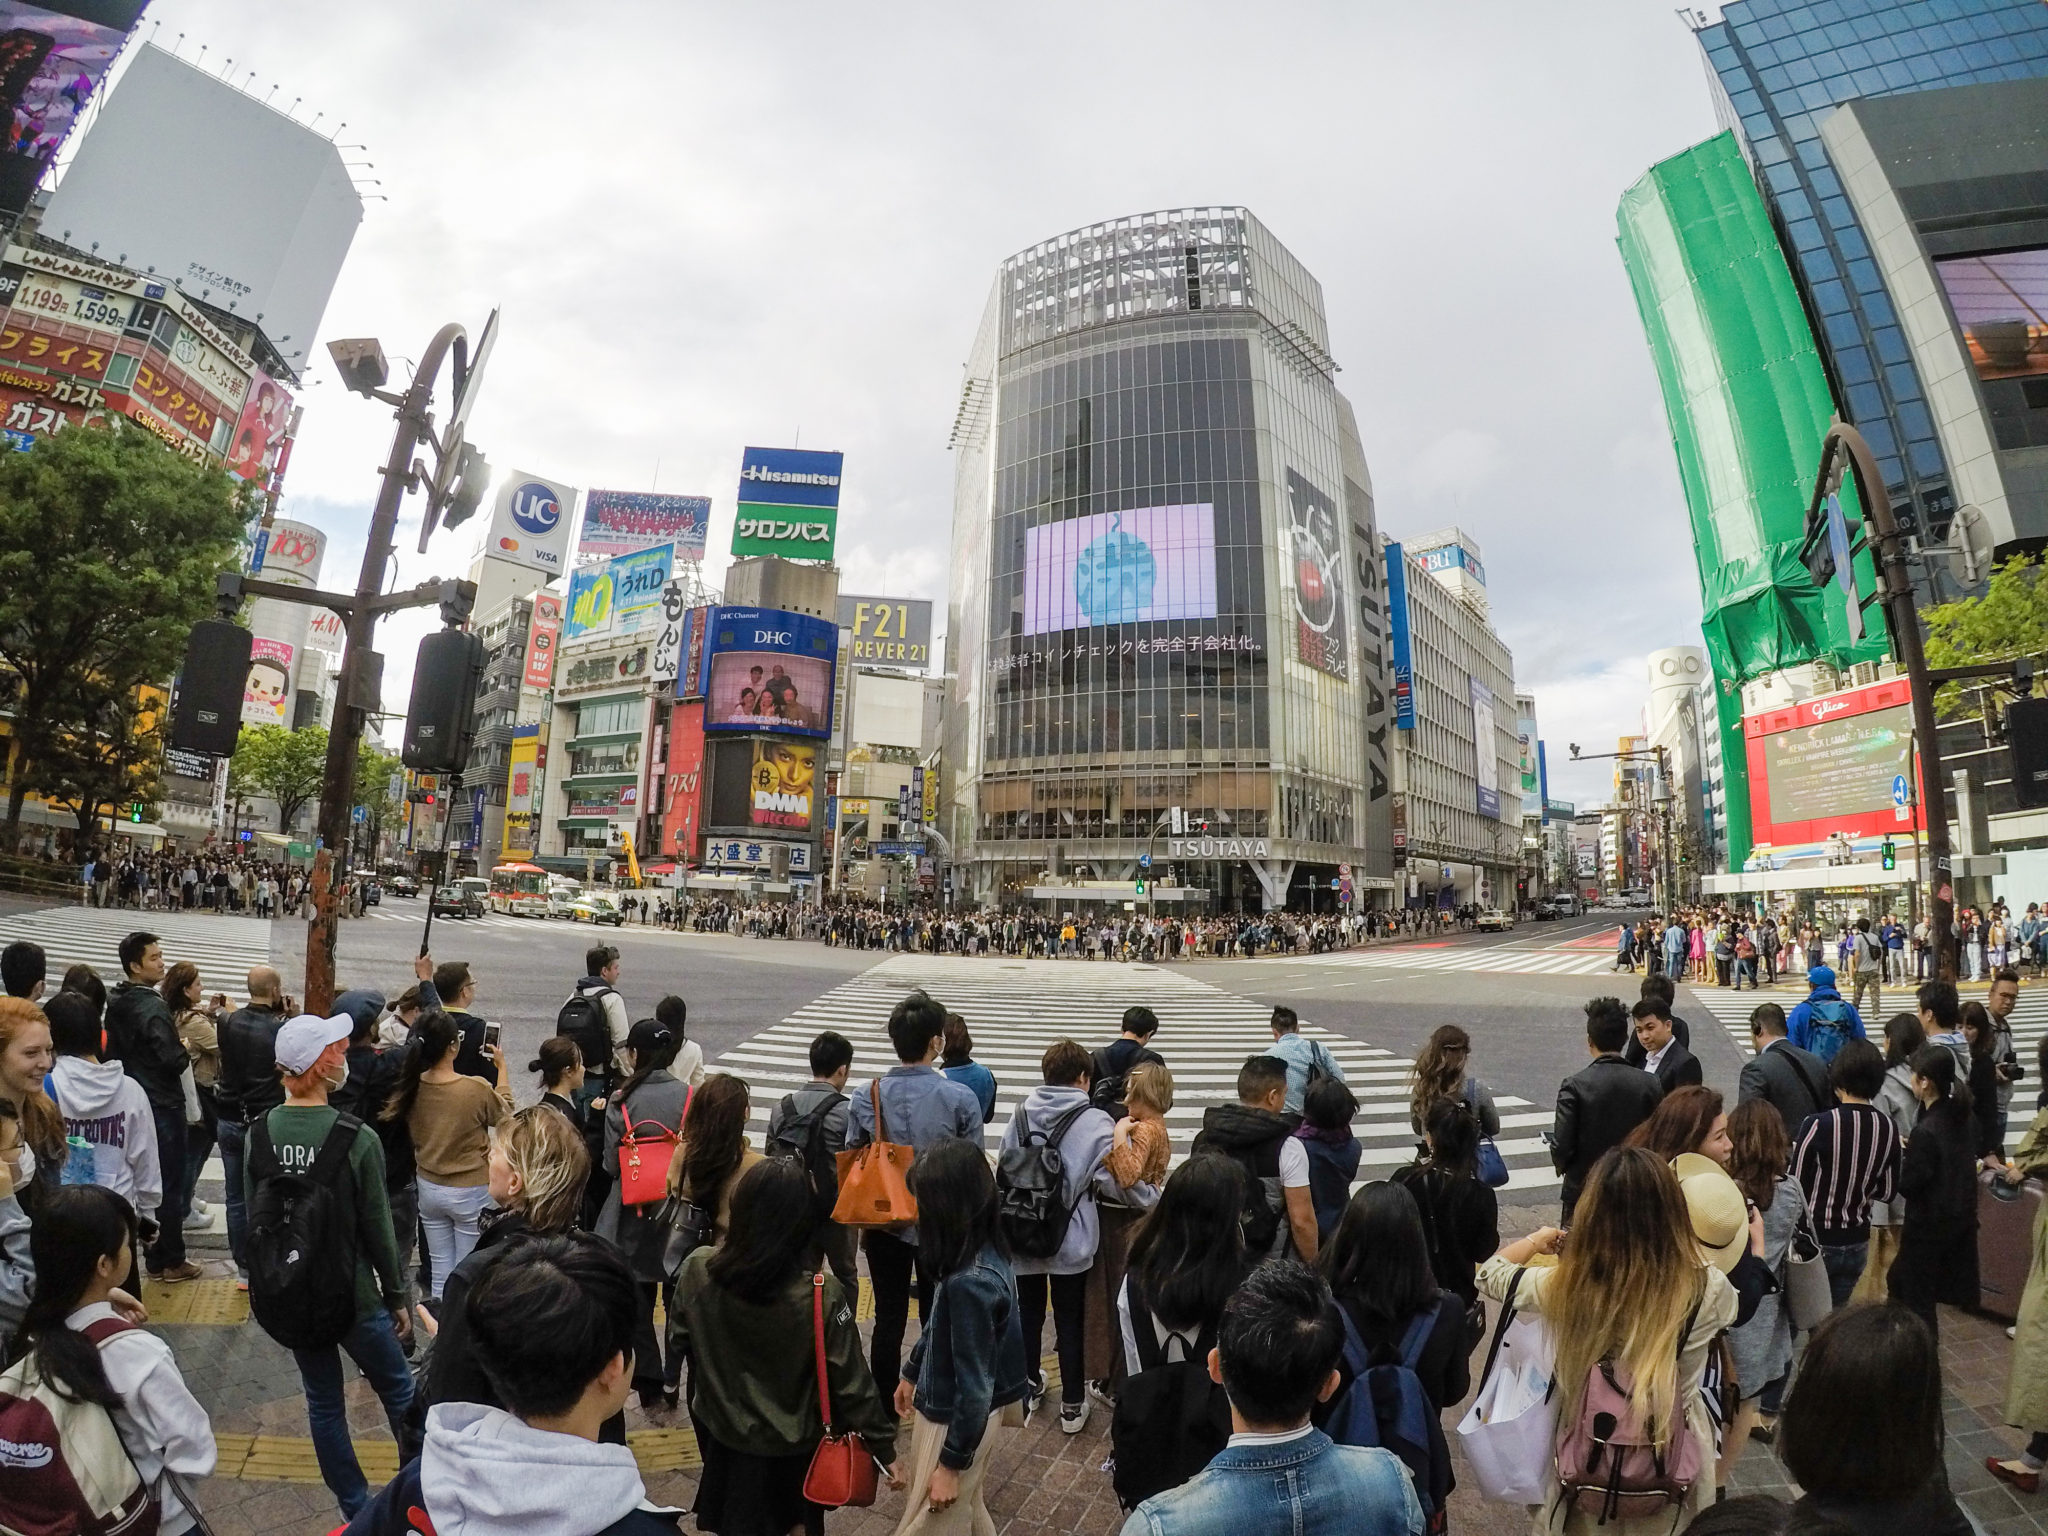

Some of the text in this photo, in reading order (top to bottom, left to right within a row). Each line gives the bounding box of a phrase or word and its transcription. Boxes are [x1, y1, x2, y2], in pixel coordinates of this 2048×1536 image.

[52, 381, 106, 408] ガスト
[136, 366, 210, 430] コンタクト
[742, 465, 839, 486] Hisamitsu
[515, 490, 557, 525] UC
[738, 518, 830, 542] サロンパス
[268, 534, 317, 567] 109
[535, 550, 558, 564] VISA
[310, 612, 342, 636] H&M
[652, 580, 684, 677] もんじゃ
[854, 602, 908, 639] F21
[754, 630, 792, 646] DHC
[910, 645, 927, 662] 21
[1354, 522, 1388, 802] TSUTAYA
[1396, 664, 1412, 718] SEIBU
[1812, 701, 1850, 720] Glico
[755, 790, 809, 814] DMM
[710, 843, 806, 866] 大盛堂店
[1172, 840, 1268, 857] TSUTAYA
[273, 1144, 322, 1167] ORA
